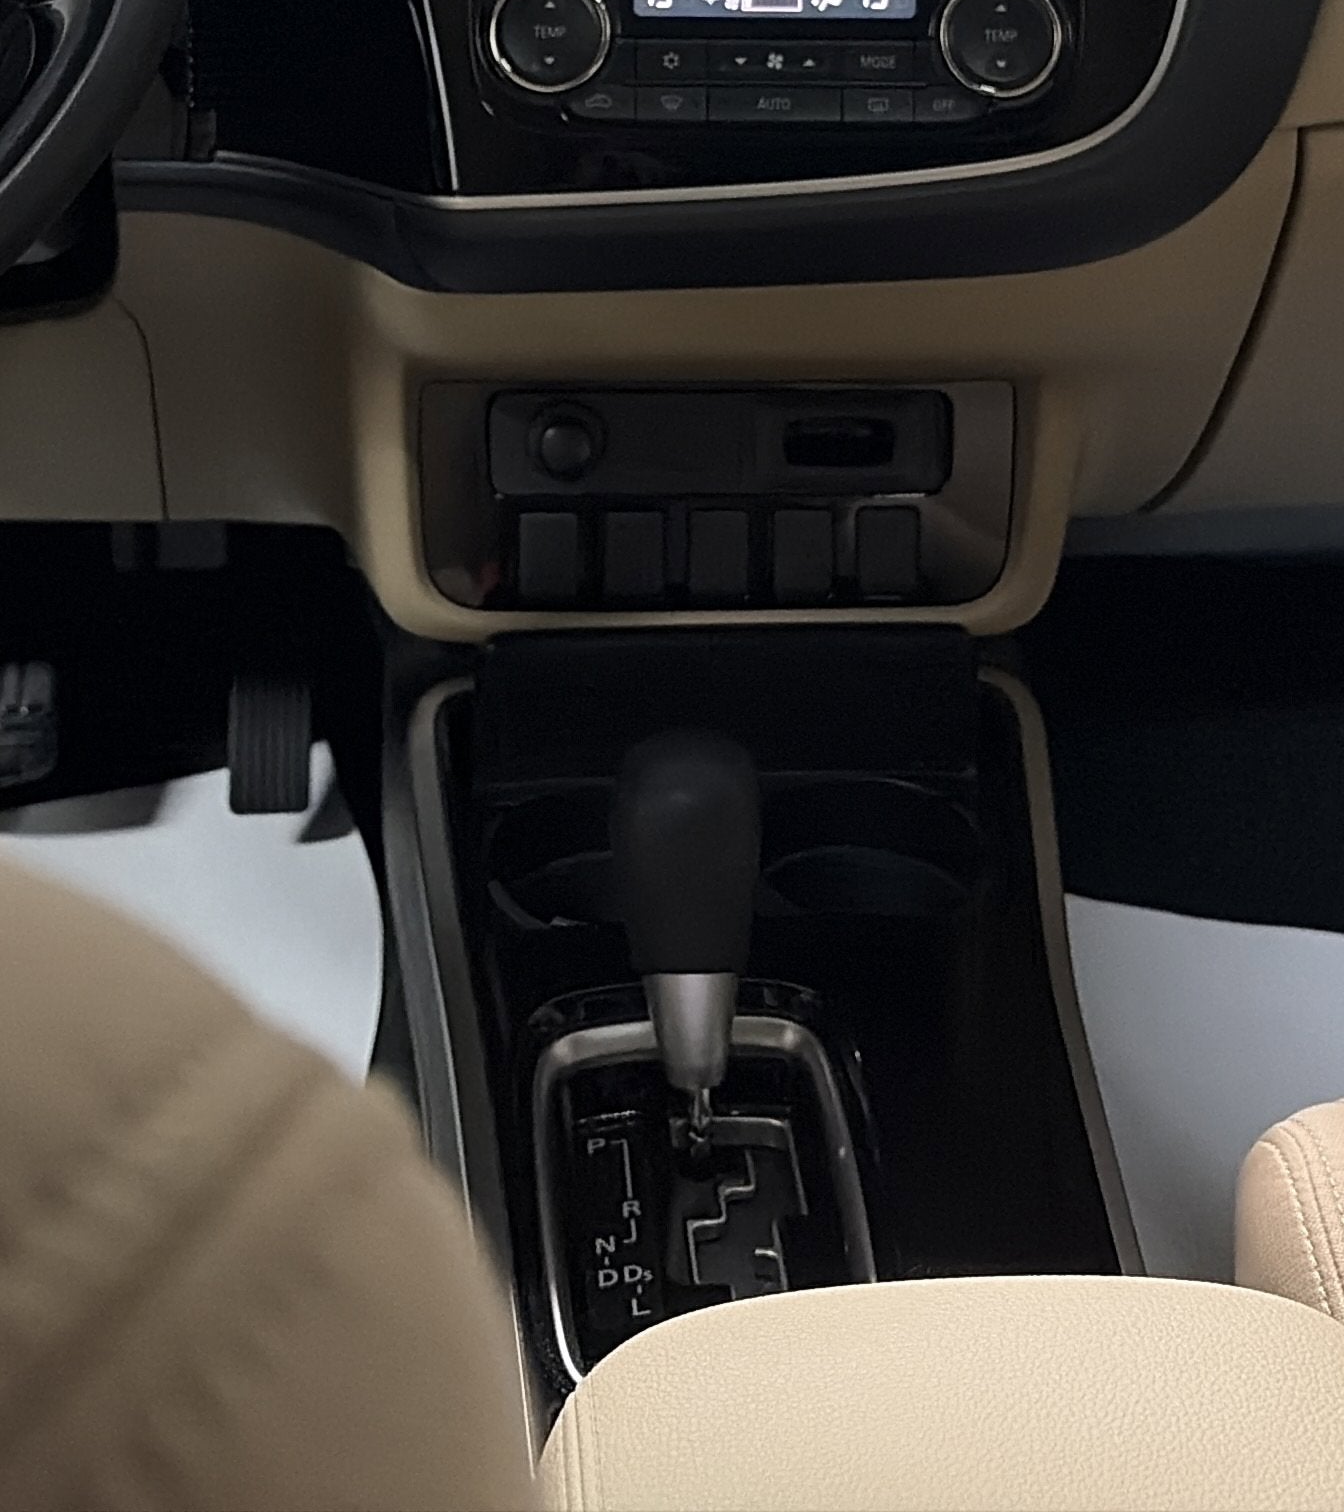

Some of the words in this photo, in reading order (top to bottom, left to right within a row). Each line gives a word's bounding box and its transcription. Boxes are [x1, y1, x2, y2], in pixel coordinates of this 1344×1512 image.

[533, 24, 567, 39] TEMP
[984, 28, 1018, 43] TEMP
[860, 55, 896, 70] MODE
[757, 97, 791, 112] AUTO
[932, 98, 955, 112] OFF
[587, 1139, 605, 1155] P
[622, 1200, 641, 1217] R
[594, 1235, 617, 1255] N
[598, 1268, 619, 1287] D
[623, 1264, 654, 1284] Ds
[631, 1297, 652, 1316] L
